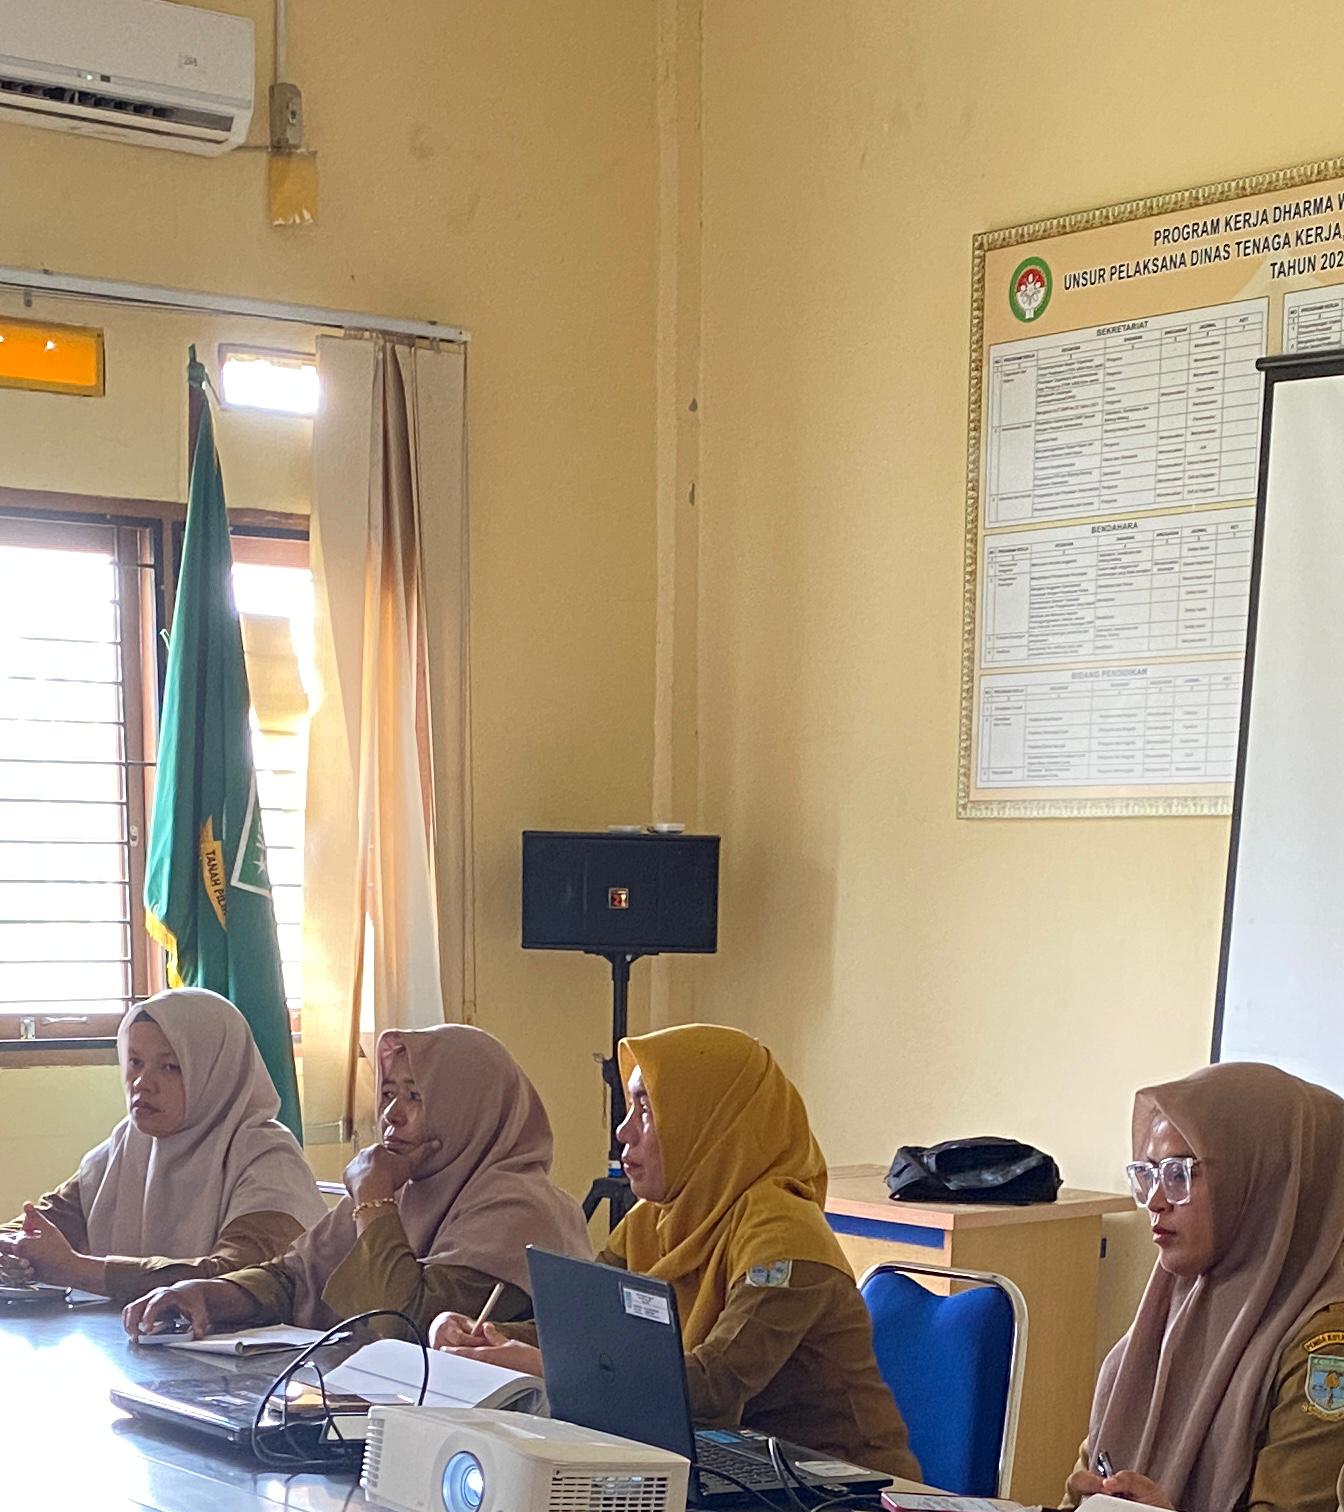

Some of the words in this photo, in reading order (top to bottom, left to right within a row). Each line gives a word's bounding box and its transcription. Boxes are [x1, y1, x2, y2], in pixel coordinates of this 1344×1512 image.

[1153, 217, 1220, 246] PROGRAM
[1224, 208, 1269, 232] KERJA
[1273, 197, 1333, 223] DHARMA
[1064, 268, 1106, 290] UNSUR
[1110, 253, 1187, 281] PELAKSANA
[1190, 243, 1230, 267] DINAS
[1234, 233, 1291, 257] TENAGA
[1295, 222, 1344, 247] KERJA,
[1270, 251, 1316, 279] TAHUN
[1096, 320, 1149, 337] SEKRETARIAT
[1091, 521, 1138, 535] BENDAHARA
[205, 849, 221, 887] TANAH
